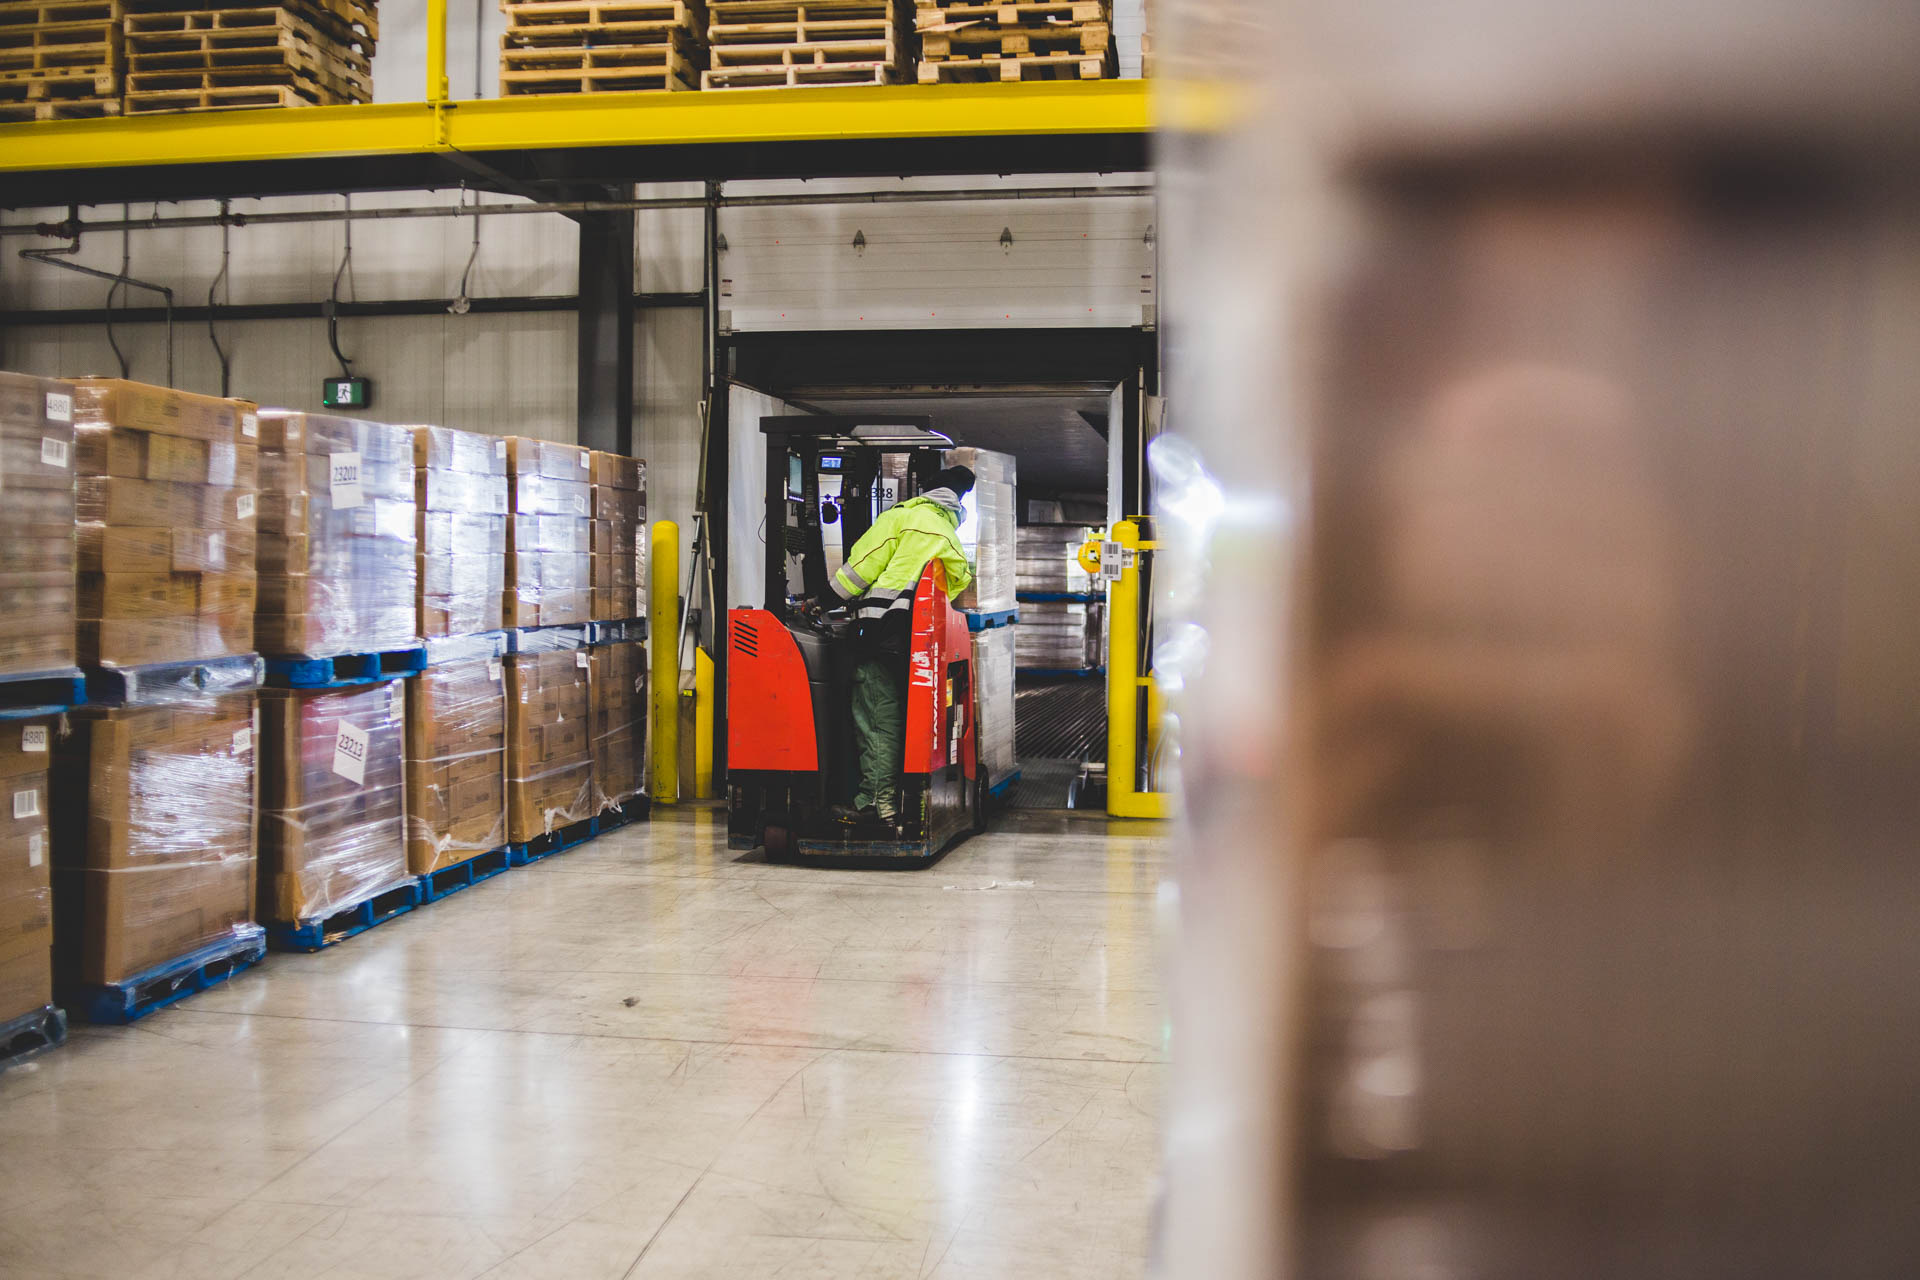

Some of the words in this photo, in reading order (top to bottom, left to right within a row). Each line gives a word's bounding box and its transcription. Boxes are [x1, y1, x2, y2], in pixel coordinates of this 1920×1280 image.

[334, 466, 357, 481] 23201
[24, 731, 45, 744] 4880
[339, 734, 363, 757] 23213
